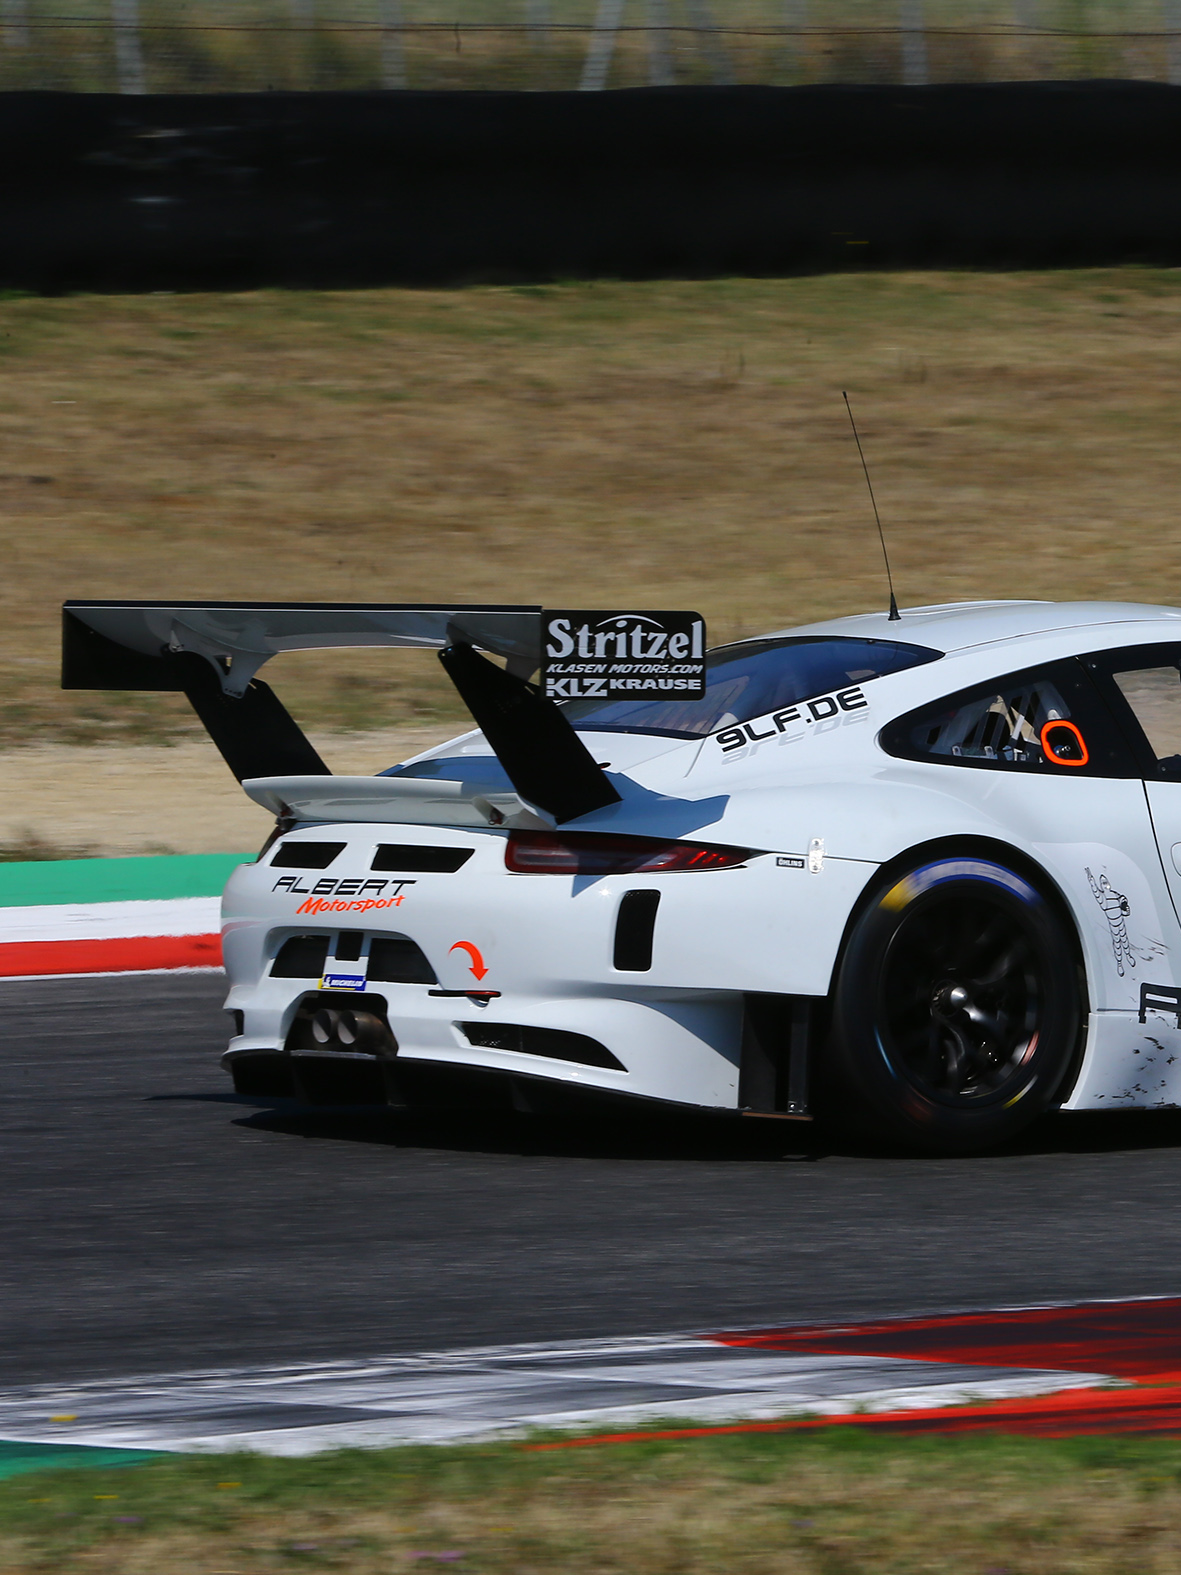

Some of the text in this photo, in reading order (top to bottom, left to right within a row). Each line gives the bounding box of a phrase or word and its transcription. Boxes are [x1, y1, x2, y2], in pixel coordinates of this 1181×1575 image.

[546, 618, 703, 658] Stritzel
[546, 664, 703, 674] KLASEN MOTORS.COM
[546, 678, 701, 697] KLZ KRAUSE
[716, 687, 869, 753] 9LF.DE
[271, 876, 417, 896] ALBERT
[296, 895, 406, 915] Motorsport
